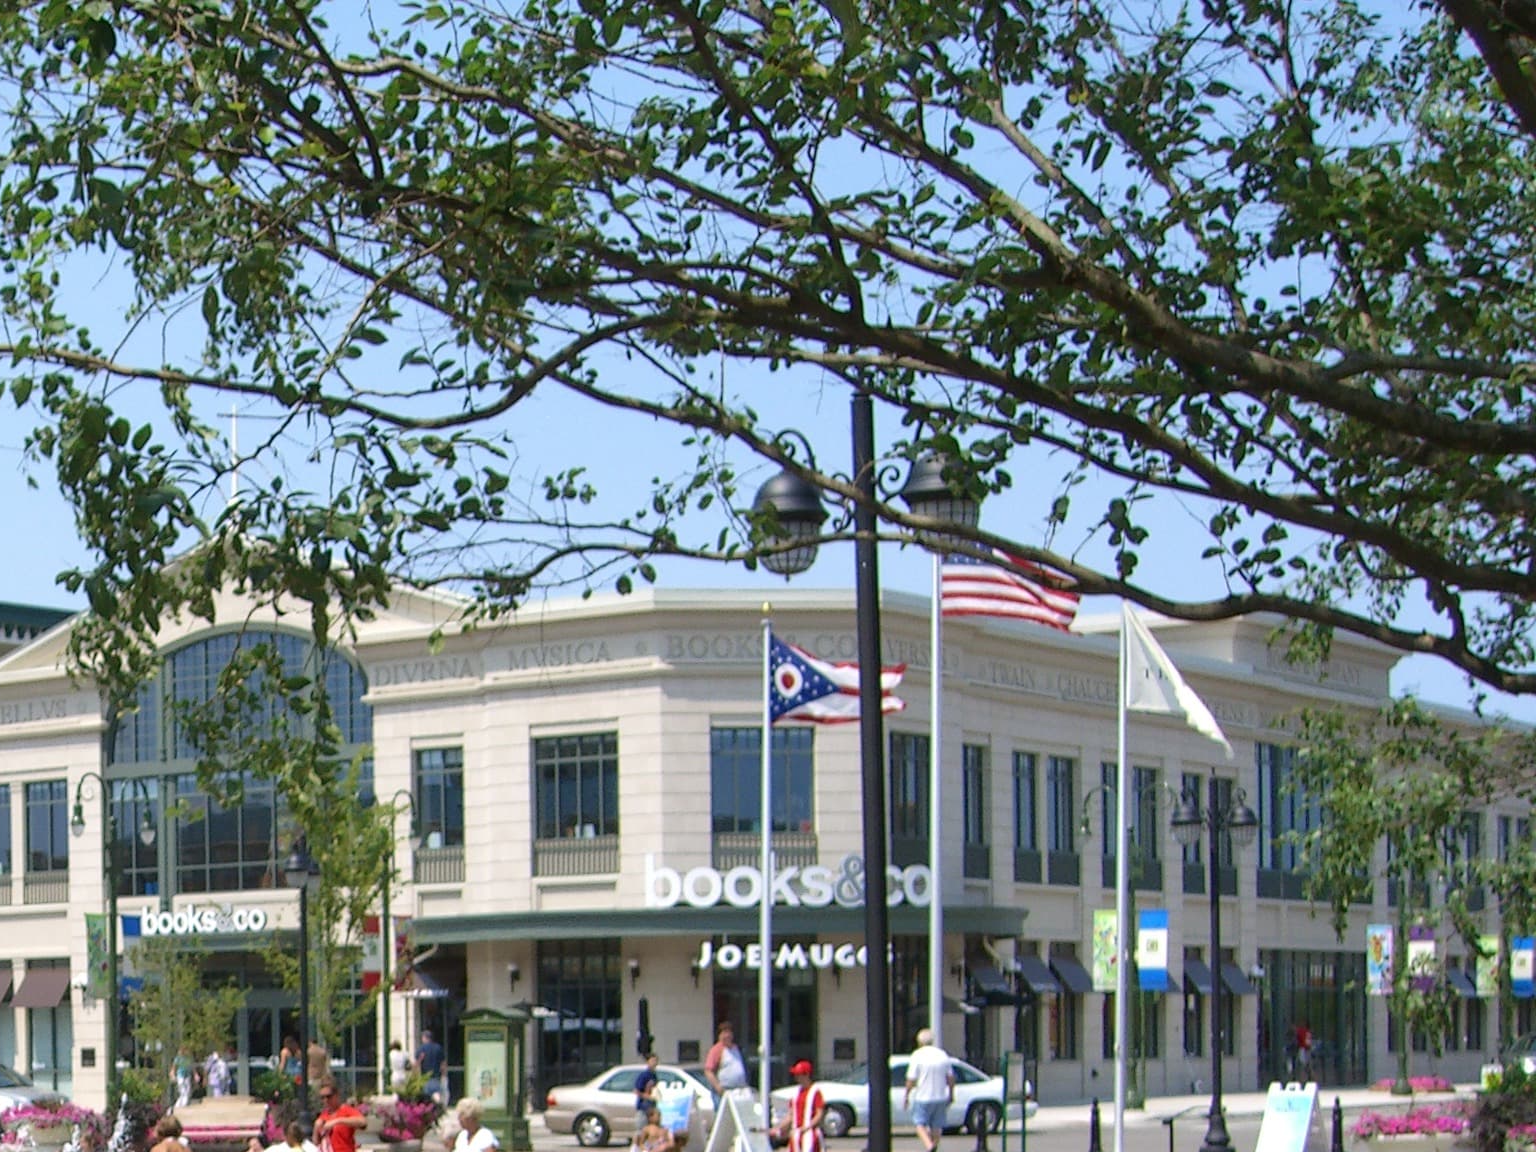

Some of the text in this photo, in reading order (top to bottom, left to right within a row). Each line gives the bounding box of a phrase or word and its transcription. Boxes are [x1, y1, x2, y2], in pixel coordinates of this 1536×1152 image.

[667, 633, 763, 659] BOOK
[644, 852, 932, 908] books&co
[141, 902, 267, 936] books&co
[699, 941, 762, 969] JOE
